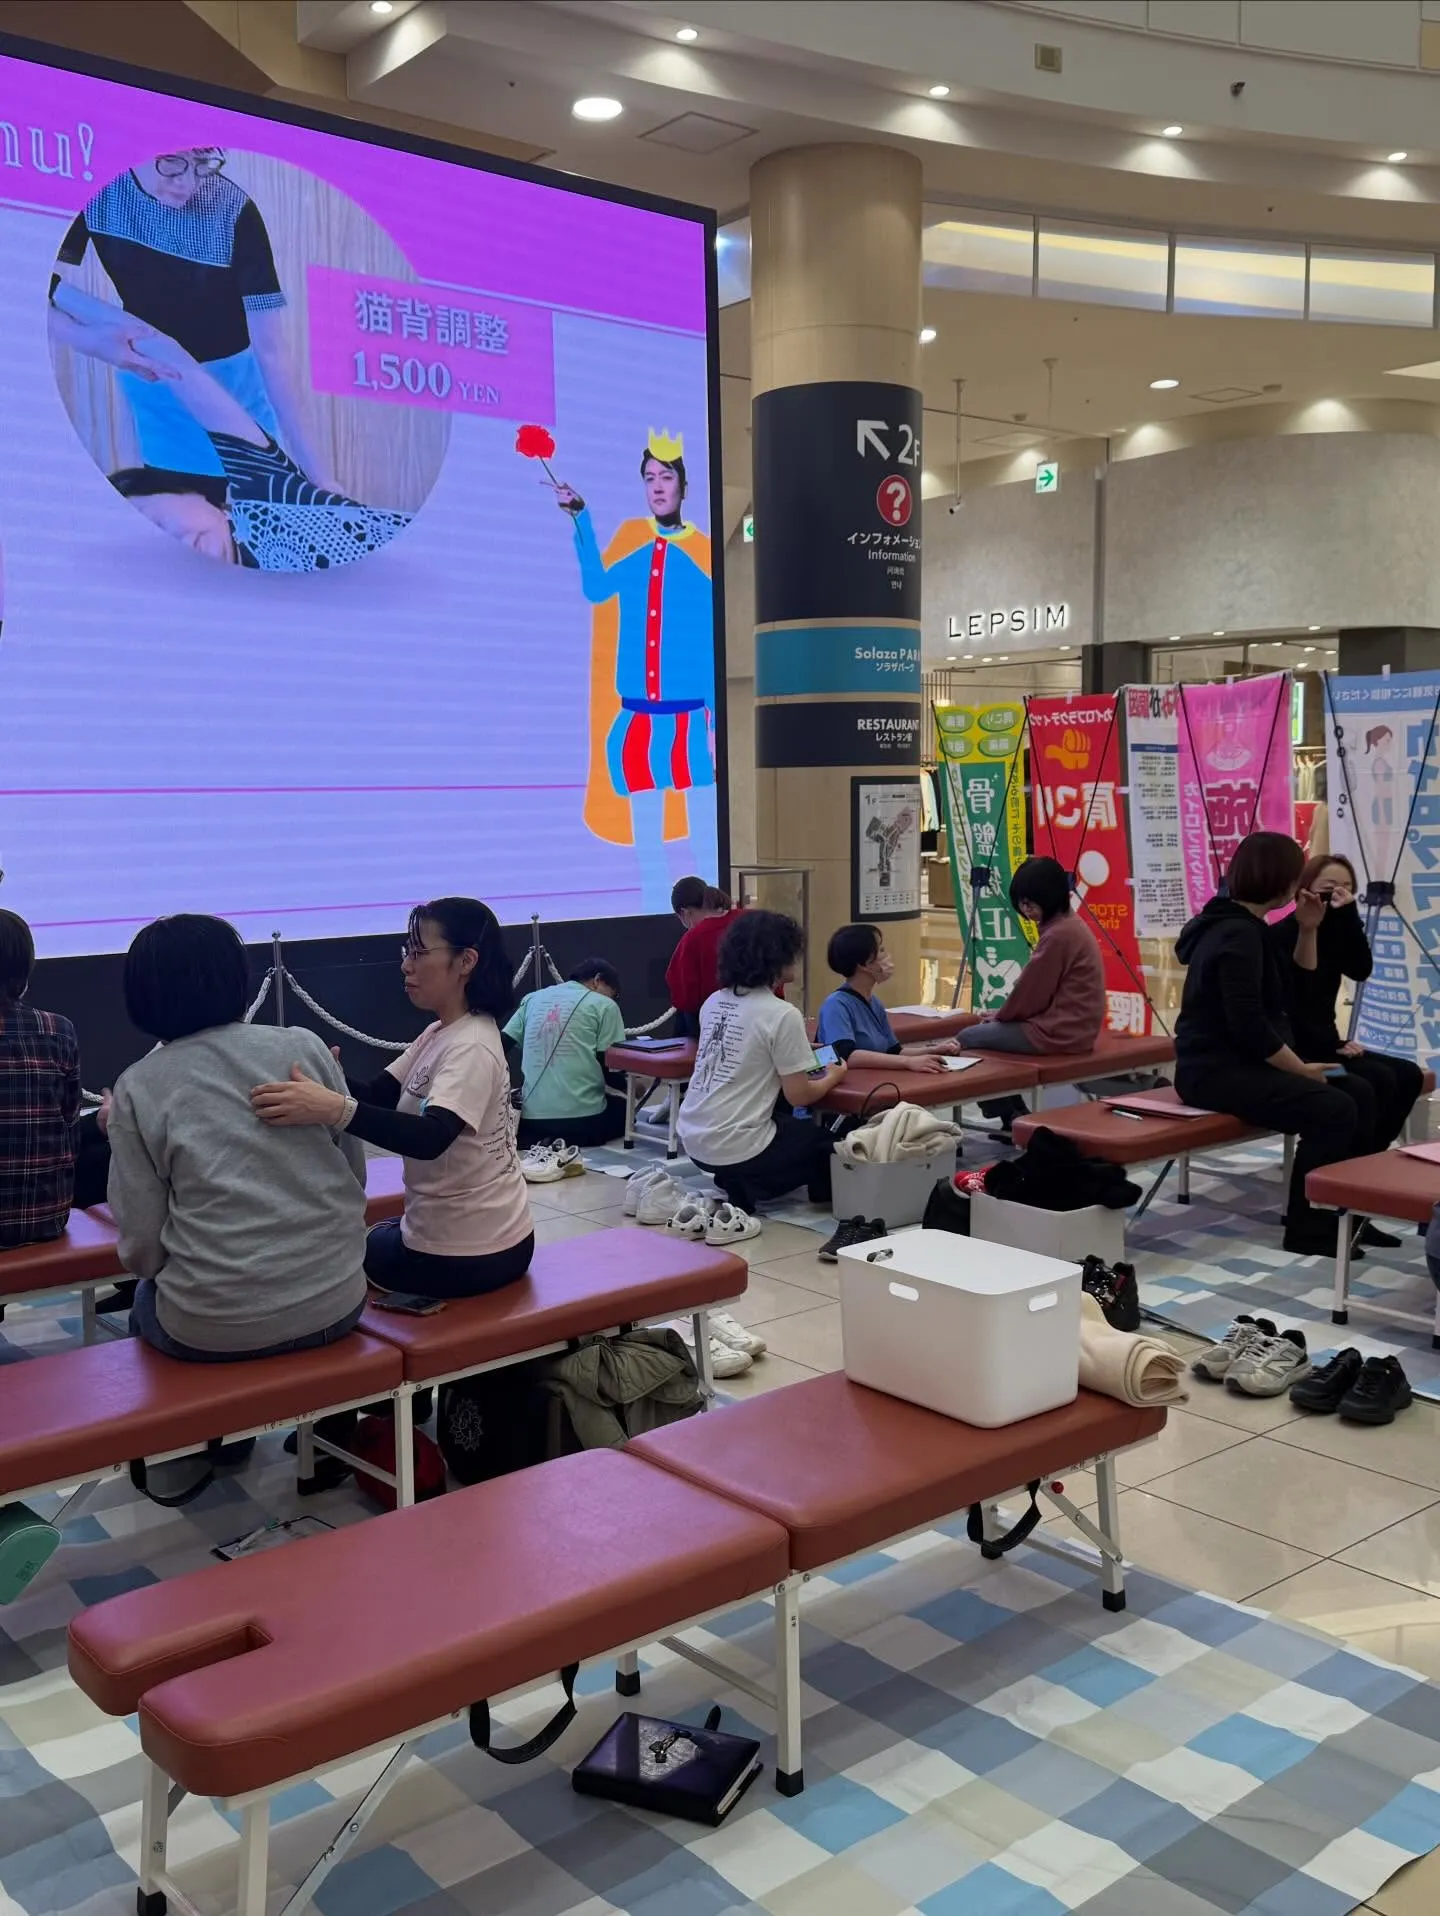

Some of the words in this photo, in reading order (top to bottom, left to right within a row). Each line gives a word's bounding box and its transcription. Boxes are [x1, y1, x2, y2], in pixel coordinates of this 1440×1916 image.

[355, 289, 510, 355] 猫背調整
[352, 350, 453, 398] 1,500
[457, 382, 501, 405] YEN
[847, 532, 921, 549] インフォメーショ
[868, 549, 917, 563] Information
[949, 604, 1066, 639] LEPSIM
[855, 646, 898, 660] Solaza
[876, 662, 916, 673] ソラザパーク
[857, 718, 920, 731] RESTAURANT
